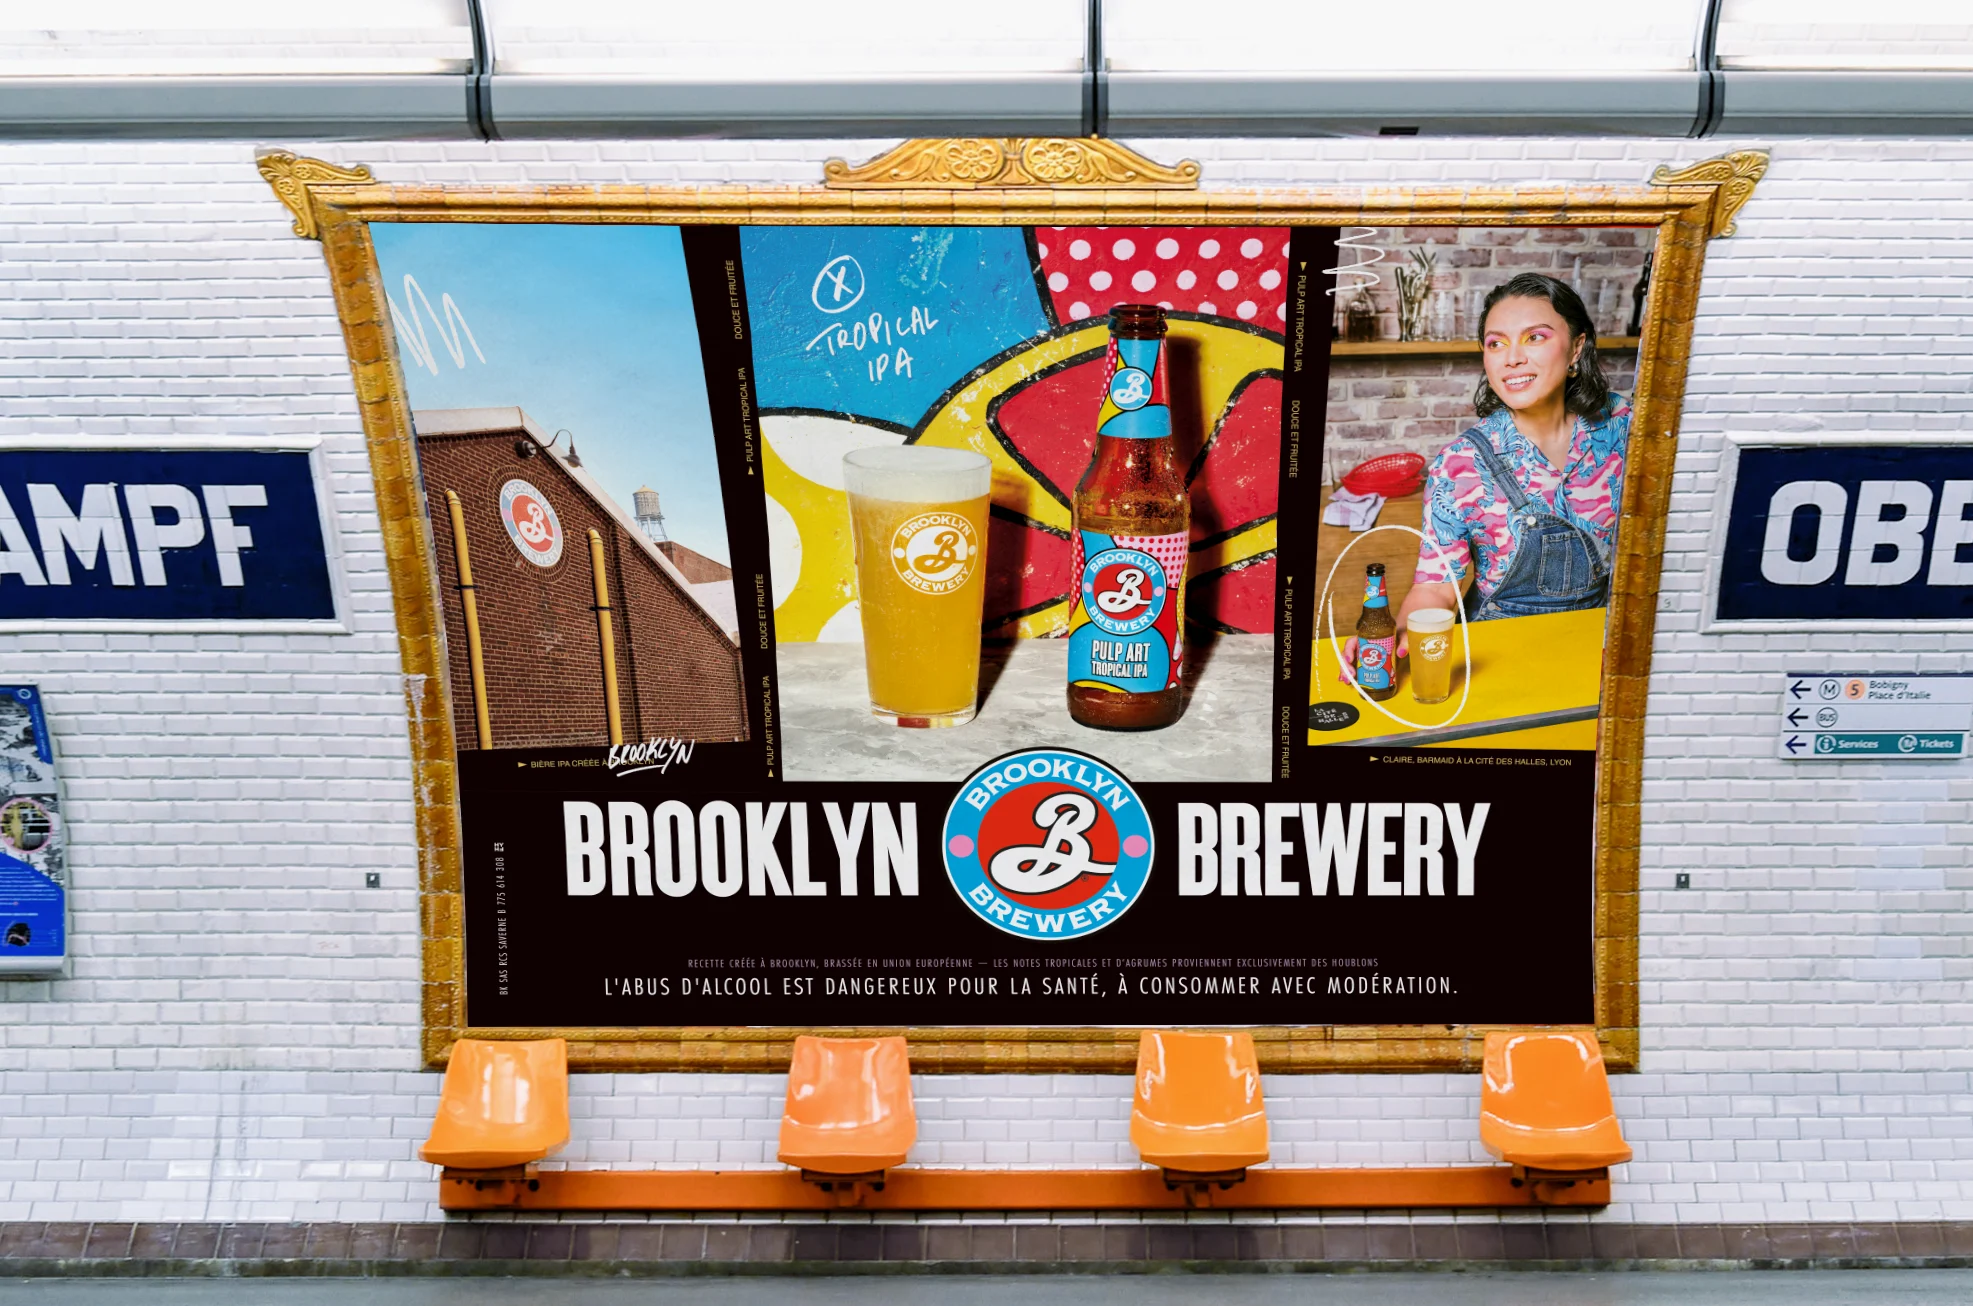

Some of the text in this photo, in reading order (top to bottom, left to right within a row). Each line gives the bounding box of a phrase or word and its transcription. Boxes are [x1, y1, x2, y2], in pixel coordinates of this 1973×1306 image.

[730, 296, 740, 308] ET
[732, 309, 743, 340] DOUCE
[806, 305, 940, 356] TROPICAL
[1293, 275, 1307, 373] PULP ART TROPICAL IPA
[868, 346, 914, 382] IPA
[737, 366, 754, 462] PULP ART TROPICAL IPA
[1290, 399, 1301, 430] DOUCE
[1290, 431, 1300, 443] ET
[503, 482, 553, 514] BROOKLYN
[900, 515, 972, 540] BROOKLYN
[514, 534, 559, 565] BREWERY
[1089, 552, 1159, 577] BROOKLYN
[901, 565, 969, 592] BREWERY
[758, 608, 767, 619] ET
[1088, 605, 1156, 632] BREWERY
[758, 621, 769, 649] DOUCE
[1282, 588, 1293, 680] PULP ART TROPICAL IPA
[1091, 639, 1151, 662] PULP ART
[1091, 660, 1148, 678] TROPICAL IPA
[1867, 691, 1932, 700] Place d'Italie
[1868, 680, 1910, 691] Bobigny
[762, 675, 775, 766] PULP ART TROPICAL IPA
[1281, 706, 1290, 734] DOUCE
[1819, 713, 1836, 722] BUS
[1281, 735, 1290, 746] ET
[1837, 738, 1955, 749] Services Tickets
[530, 759, 556, 768] BIÈRE
[557, 760, 571, 768] IPA
[571, 758, 600, 767] CRÉÉE
[608, 736, 695, 774] BROOKLYN
[1382, 755, 1572, 767] CLAIRE, BARMAID À LA CITÉ DES HALLES, LYON
[964, 758, 1131, 812] BROOKLYN
[564, 800, 1491, 898] BROOKLYN BREWERY
[495, 857, 505, 872] 308
[495, 875, 505, 889] 614
[496, 892, 506, 906] 775
[967, 881, 1128, 933] BREWERY
[497, 917, 508, 950] SAVERNE
[498, 952, 508, 966] RCS
[688, 957, 1379, 969] RECETTE CRÉÉE À BROOKLYN, BRASSÉE EN UNION EUROPÉENNE LES NOTES TROPICALES ET D'AGRUMES PROVIENNENT EXCLUSIVEMENT DES HOUBLONS
[498, 969, 508, 983] SAS
[604, 973, 1458, 998] L'ABUS D'ALCOOL EST DANGEREUX POUR LA SANTÉ, À CONSOMMER AVEC MODÉRATION.
[498, 986, 509, 996] BK
